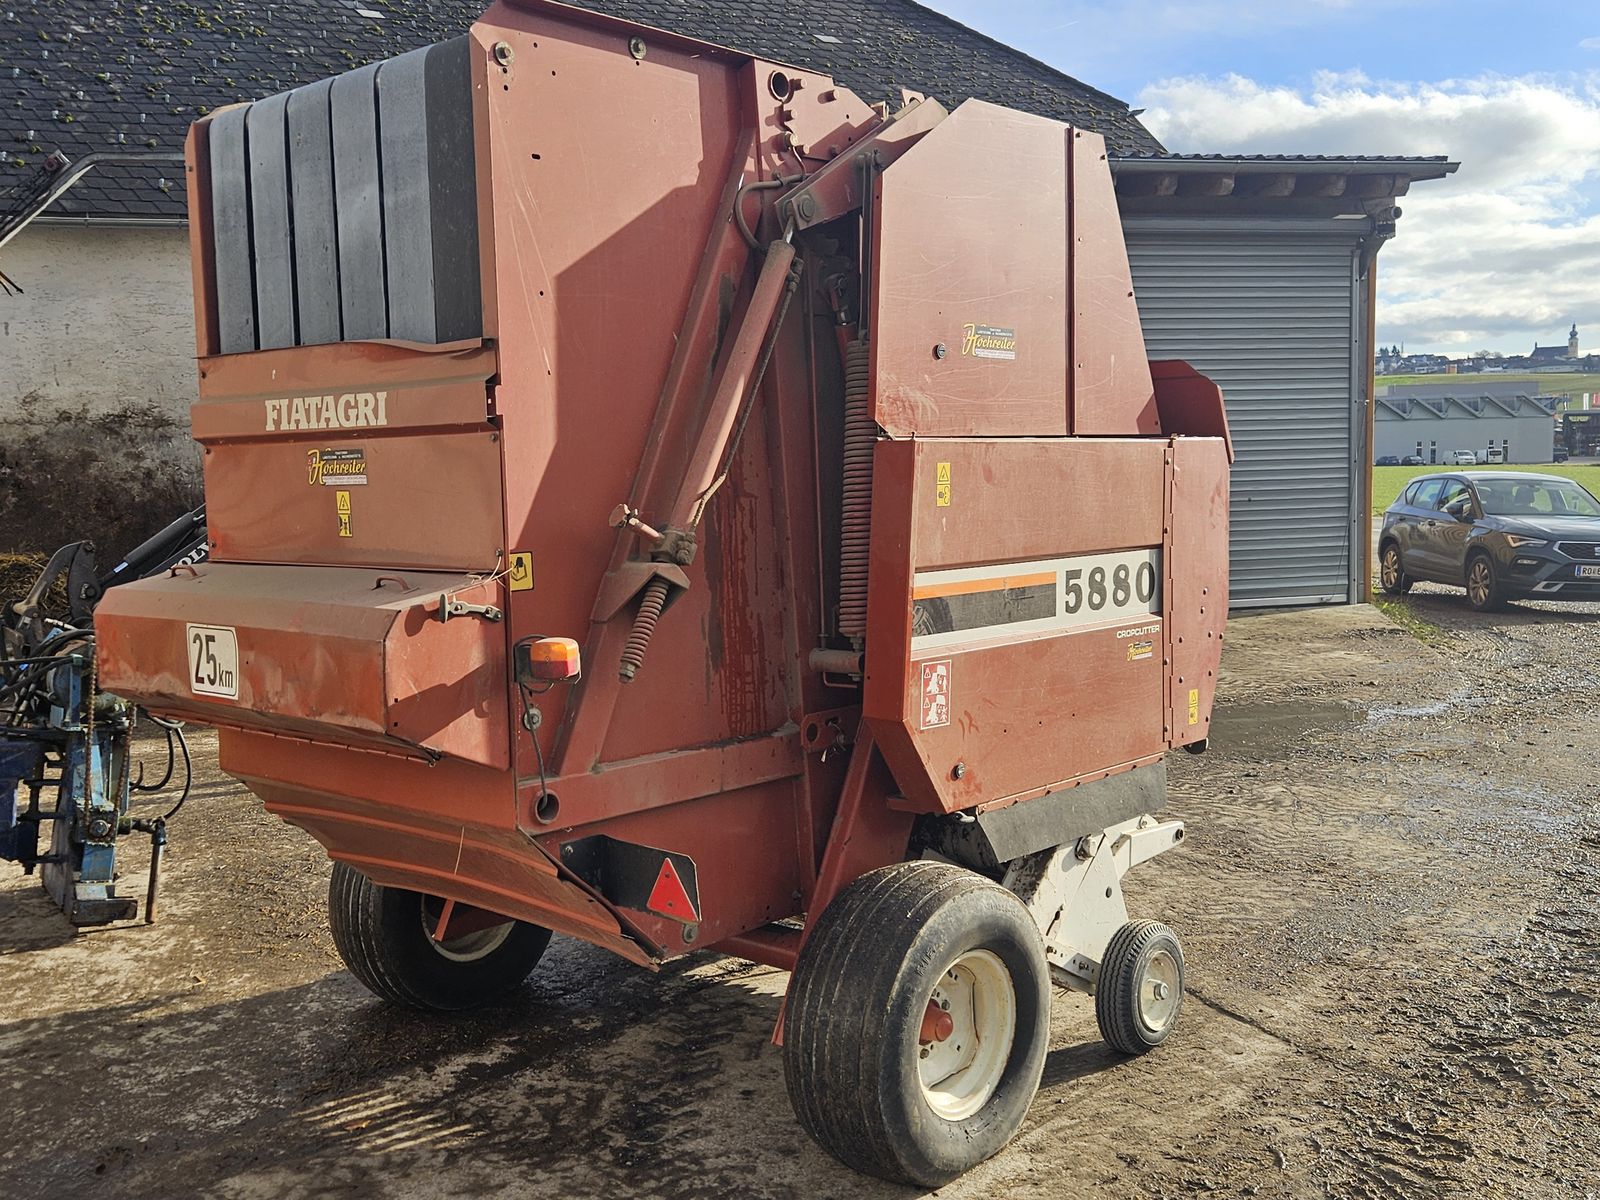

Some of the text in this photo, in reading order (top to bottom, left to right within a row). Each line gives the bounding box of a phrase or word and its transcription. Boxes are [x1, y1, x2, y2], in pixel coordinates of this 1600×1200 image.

[265, 392, 387, 431] FIATAGRI
[307, 449, 366, 485] Hochreiter
[1065, 561, 1155, 614] 5880
[1117, 625, 1160, 638] CROPCUTTER
[192, 633, 233, 689] 25 km
